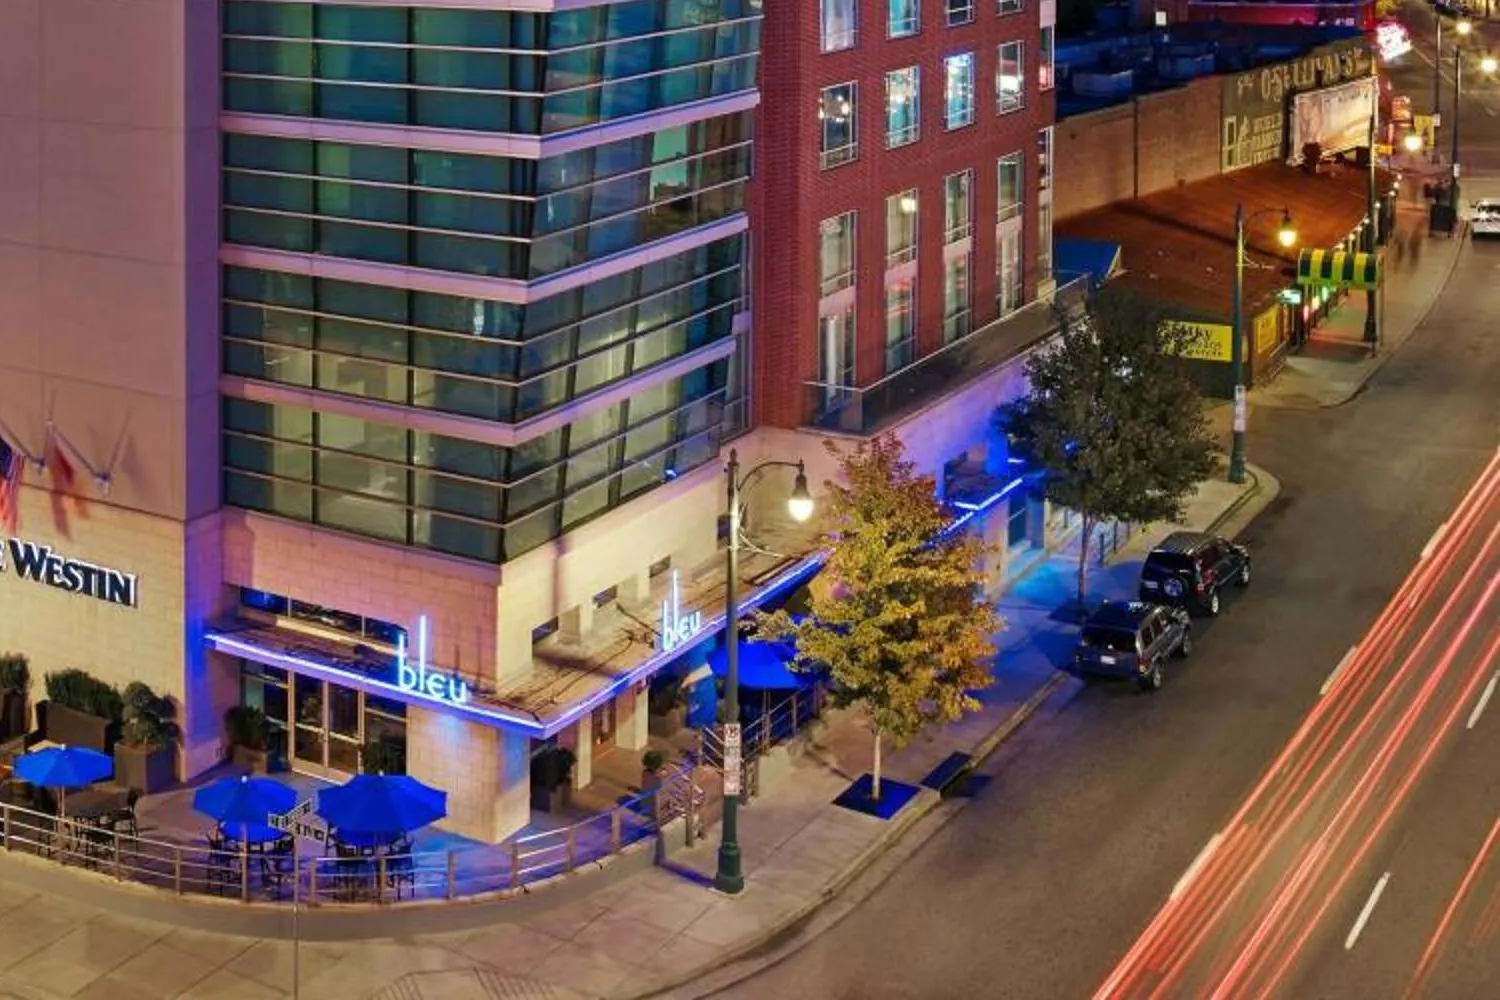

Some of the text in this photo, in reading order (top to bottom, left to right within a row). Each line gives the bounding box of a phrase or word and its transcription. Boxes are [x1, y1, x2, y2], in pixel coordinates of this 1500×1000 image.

[8, 537, 138, 608] WESTIN
[663, 570, 701, 651] bleu
[398, 615, 466, 703] bleu
